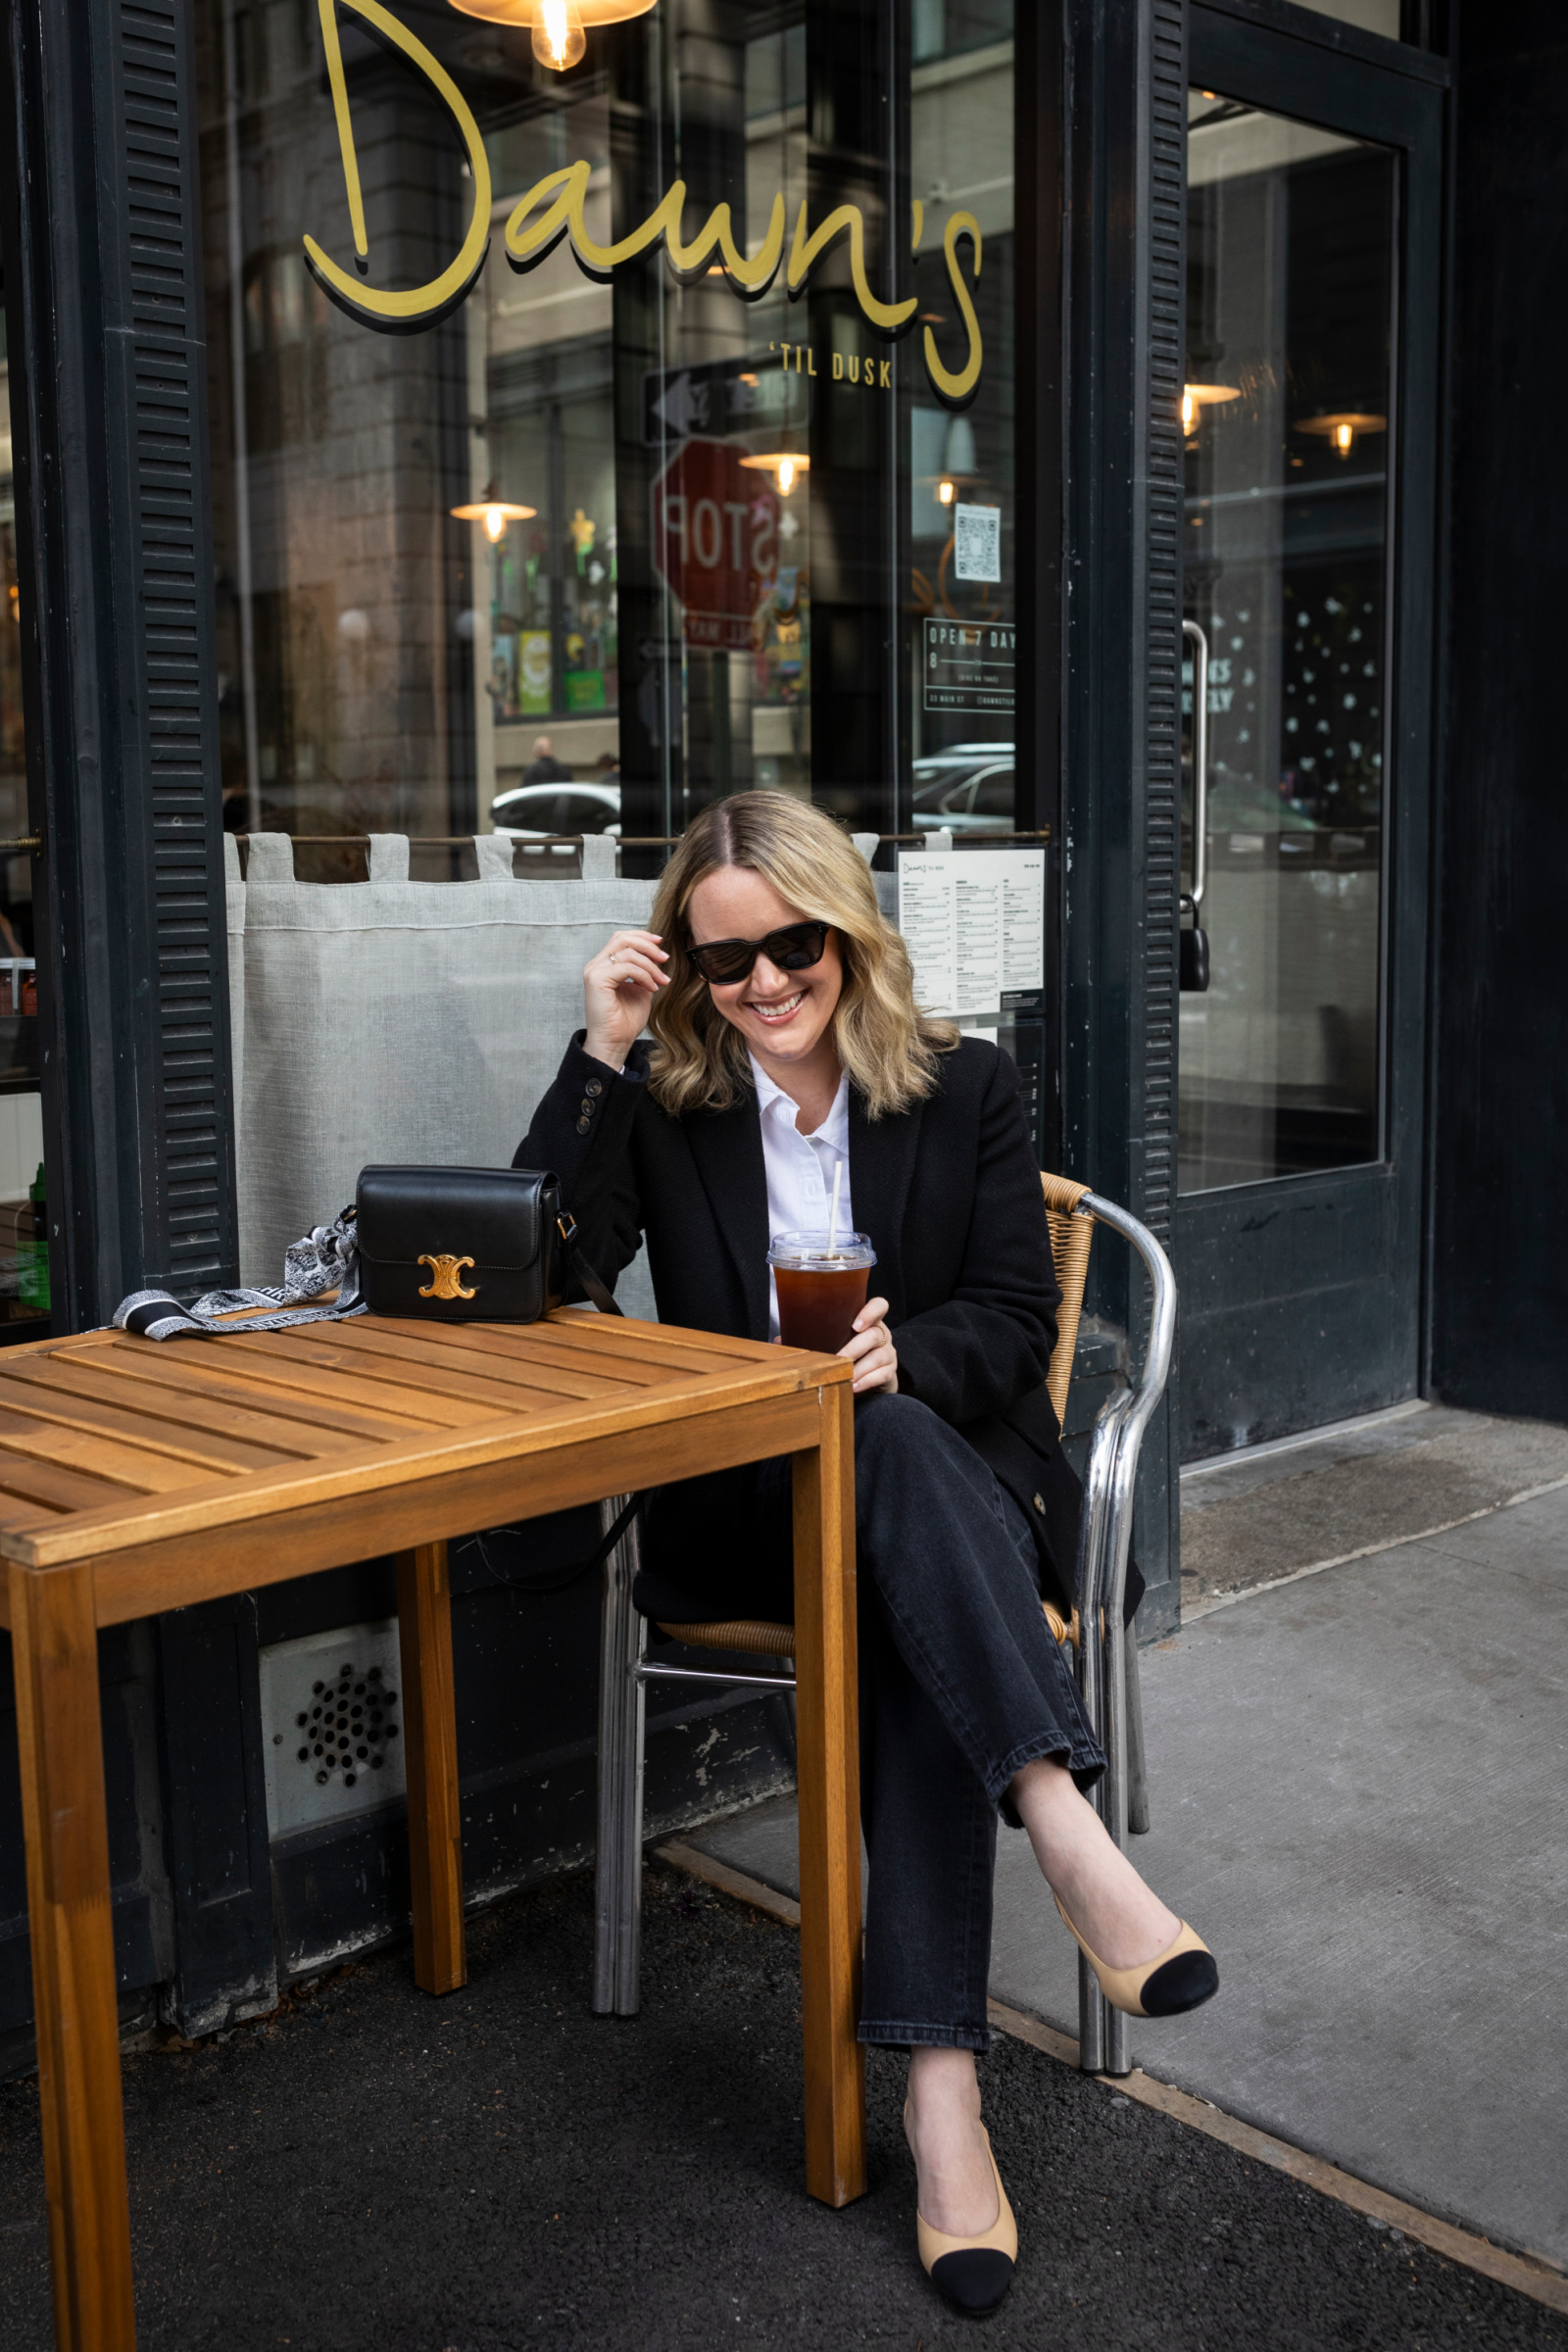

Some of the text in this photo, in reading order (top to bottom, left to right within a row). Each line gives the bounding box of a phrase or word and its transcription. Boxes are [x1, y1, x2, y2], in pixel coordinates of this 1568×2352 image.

[303, 0, 983, 400] Dawn's
[833, 353, 891, 389] DUSK
[930, 627, 966, 646] OPEN
[975, 630, 982, 647] 7
[930, 653, 937, 668] 8
